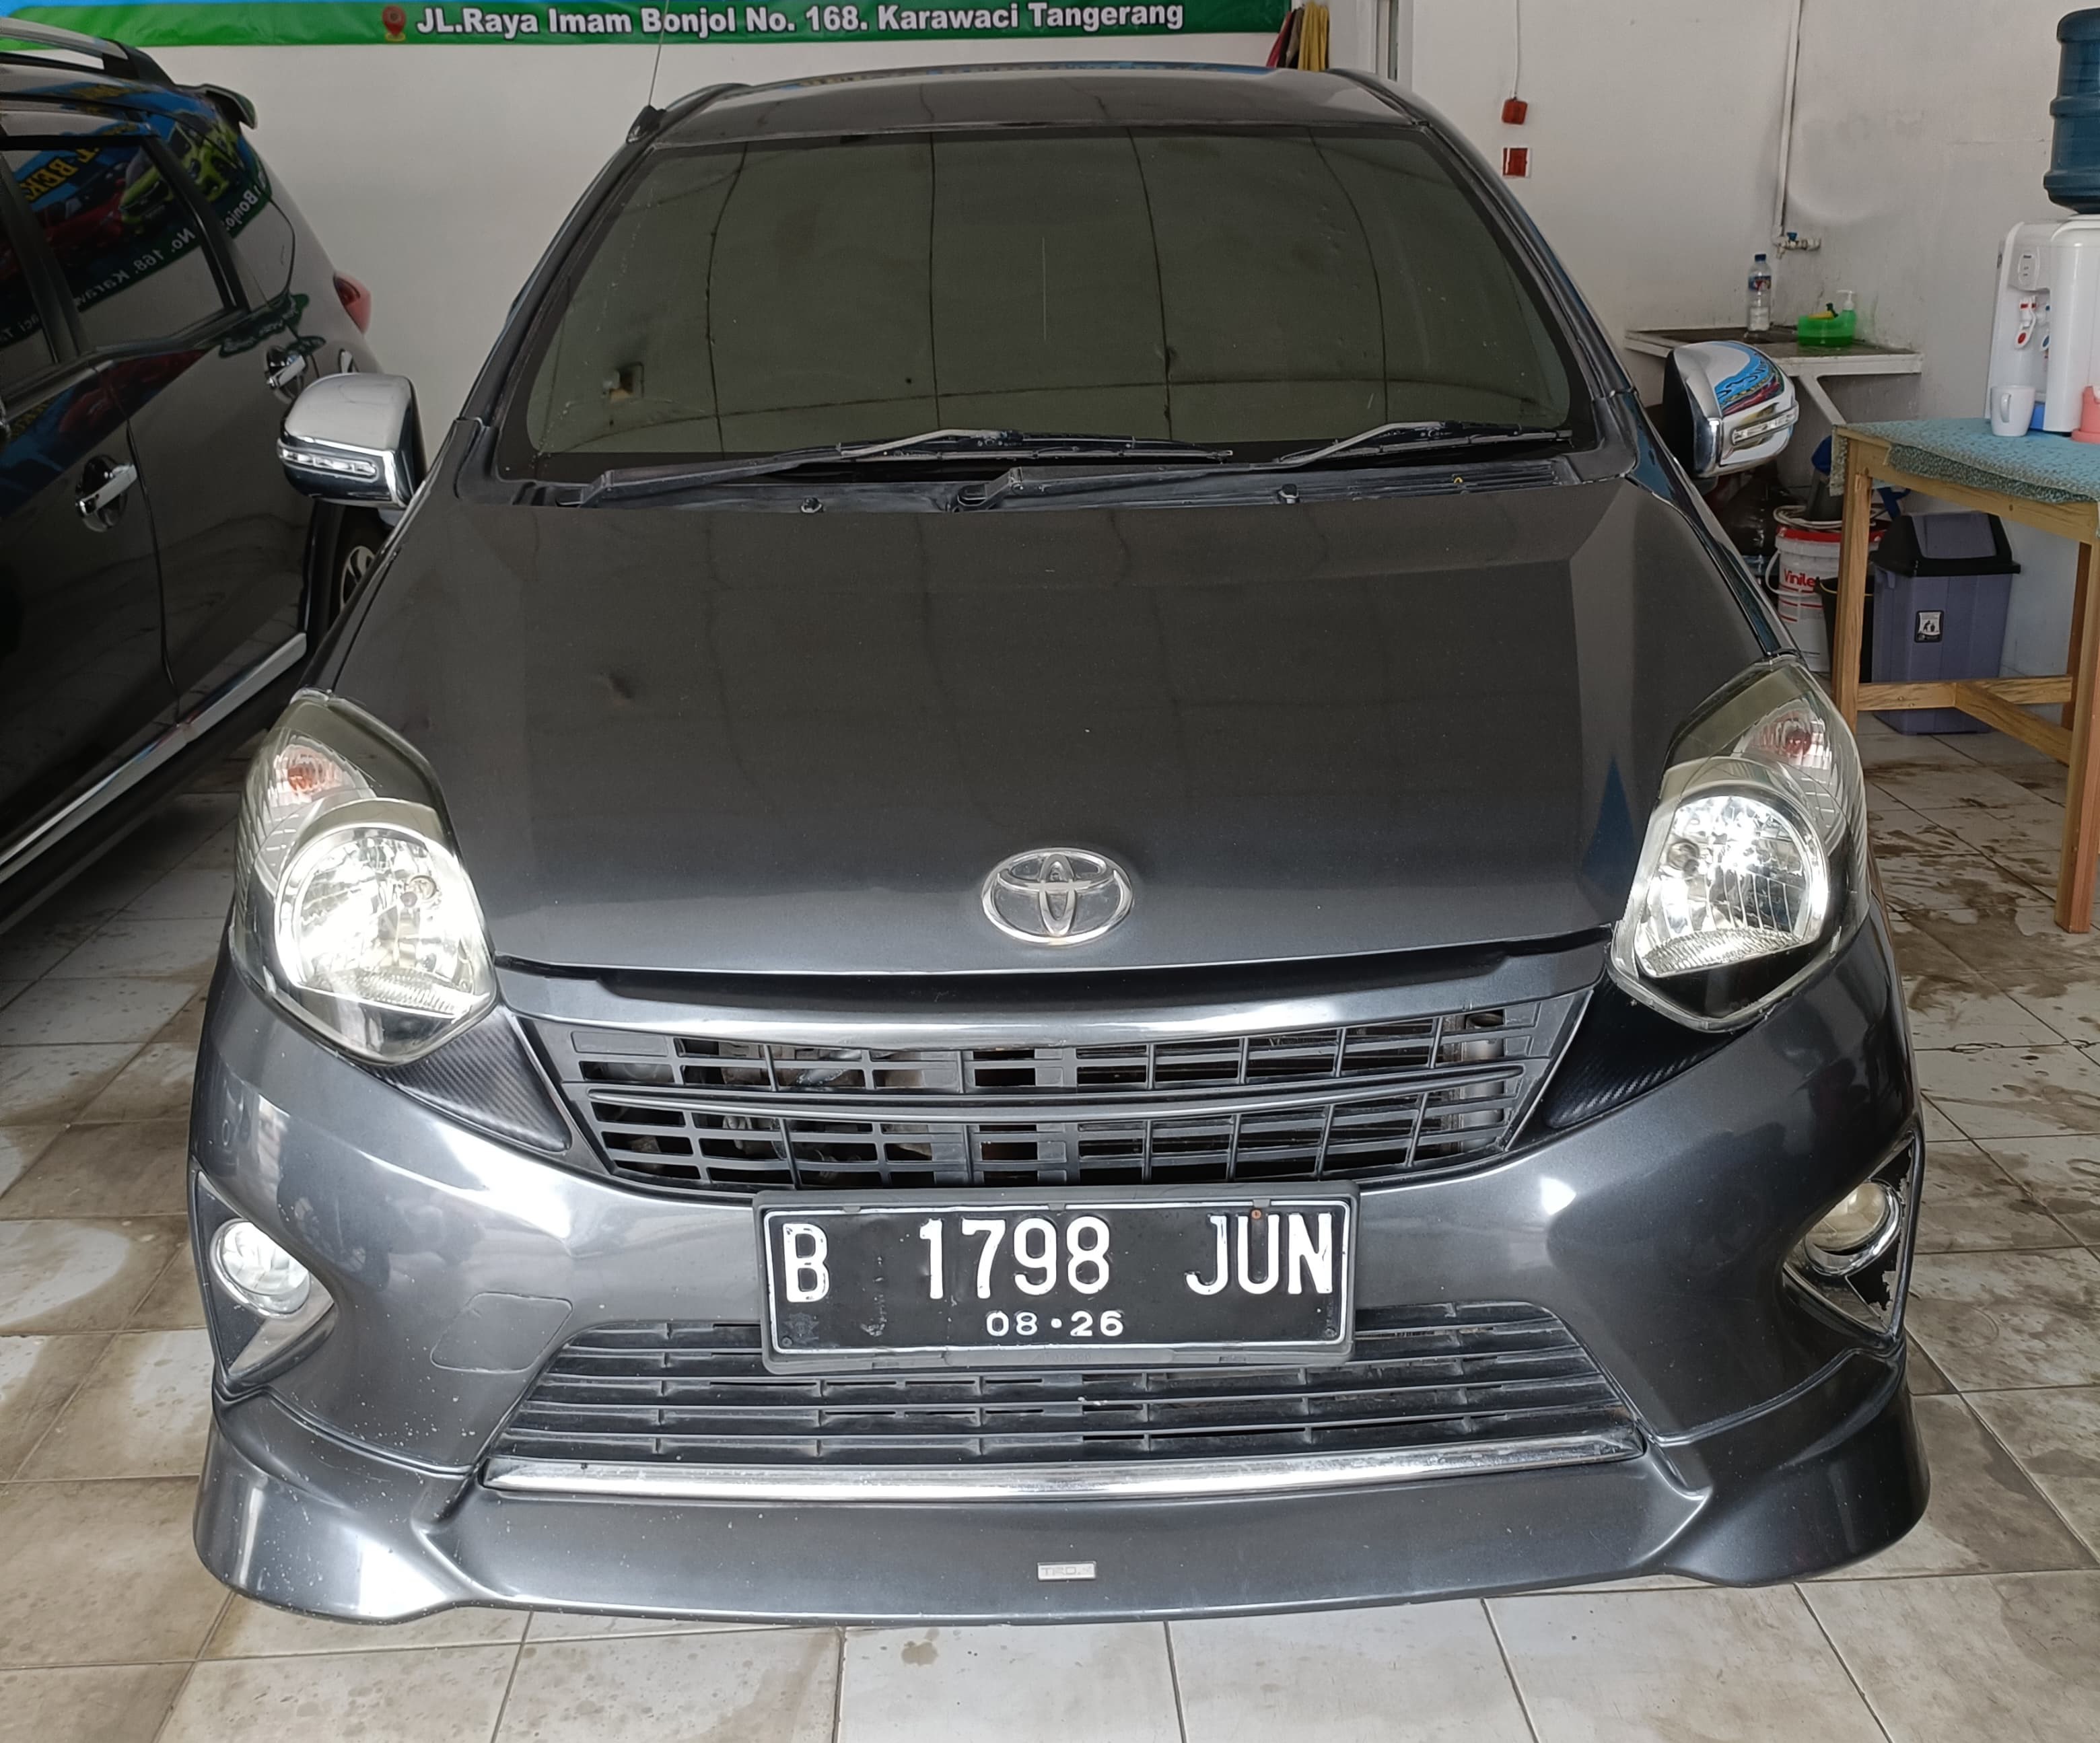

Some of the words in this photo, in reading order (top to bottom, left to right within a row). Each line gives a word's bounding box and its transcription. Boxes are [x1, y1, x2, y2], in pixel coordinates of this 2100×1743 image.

[417, 7, 538, 39] JL.Raya
[549, 8, 633, 33] Imam
[641, 7, 736, 38] Bonjol
[746, 7, 796, 32] No.
[805, 5, 868, 31] 168.
[877, 3, 1018, 30] Karawaci
[1027, 2, 1183, 32] Tangerang
[1784, 568, 1817, 588] Vinile
[782, 1223, 831, 1303] B
[919, 1215, 1111, 1300] 1798
[1185, 1212, 1334, 1296] JUN
